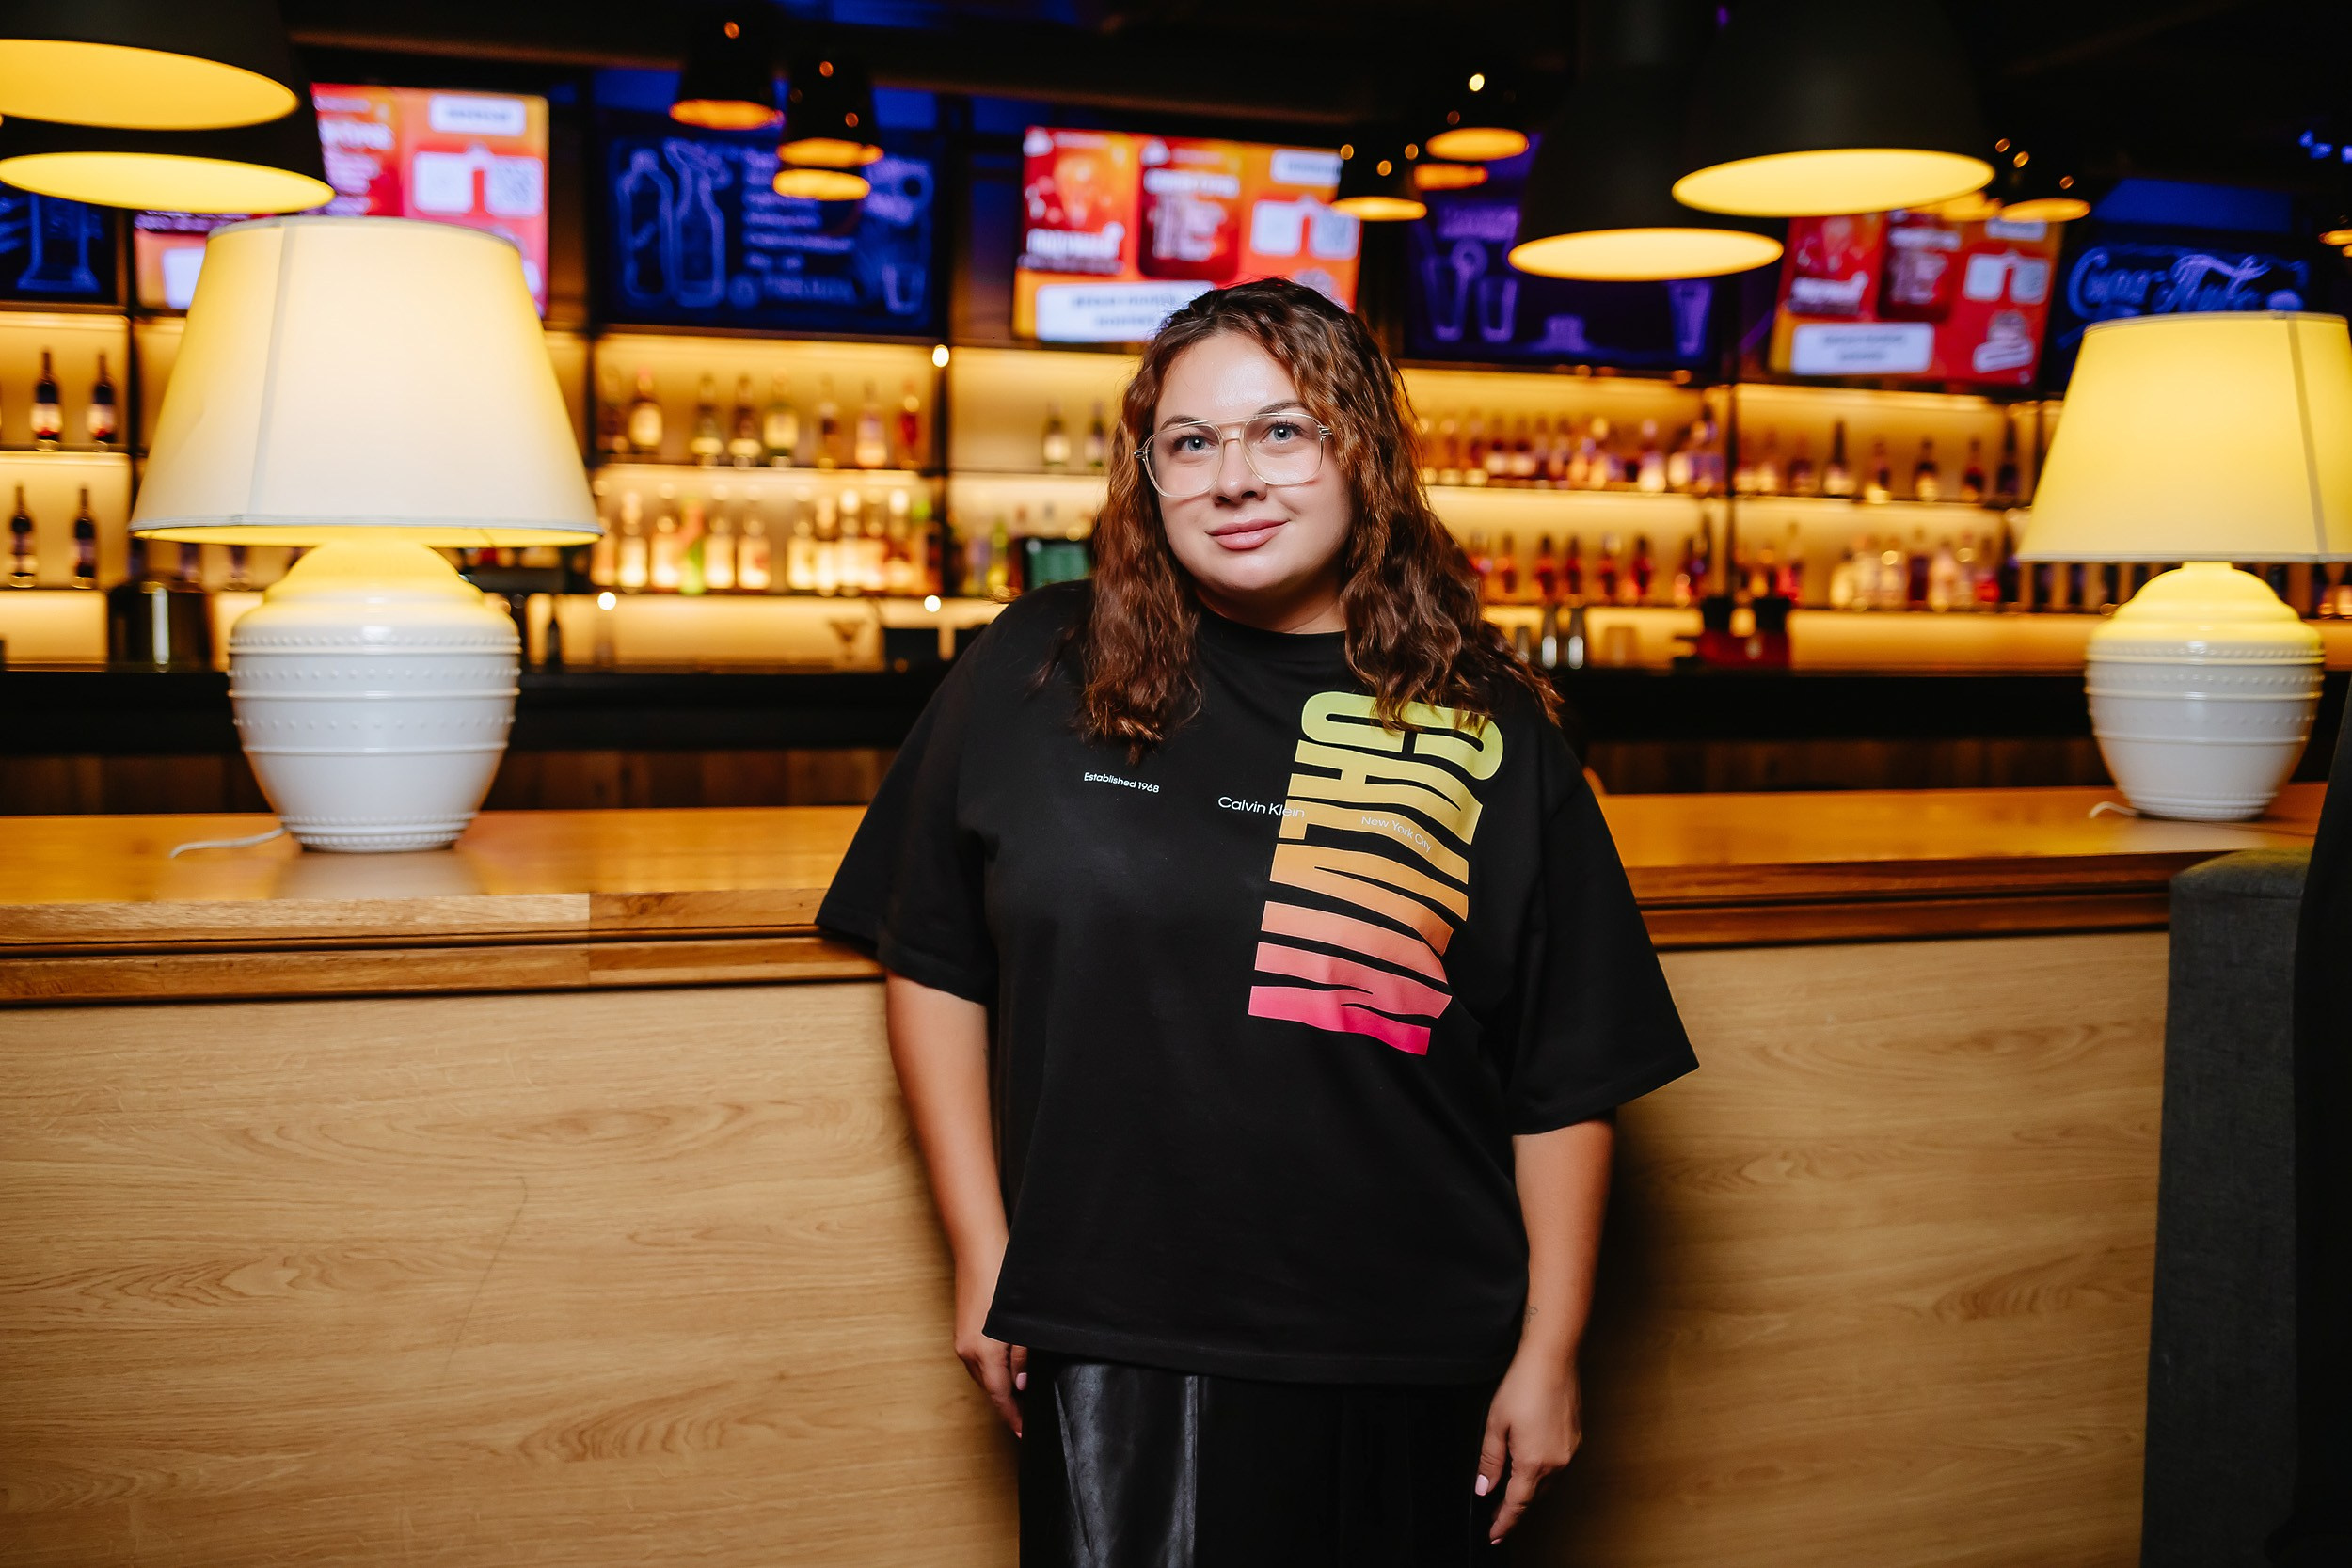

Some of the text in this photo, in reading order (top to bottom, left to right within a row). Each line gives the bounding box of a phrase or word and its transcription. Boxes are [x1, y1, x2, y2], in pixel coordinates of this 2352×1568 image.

[1084, 772, 1160, 793] Established 1968
[1217, 796, 1305, 818] Calvin Klein
[1361, 816, 1432, 853] New York City
[1248, 691, 1504, 1055] CALVIN
